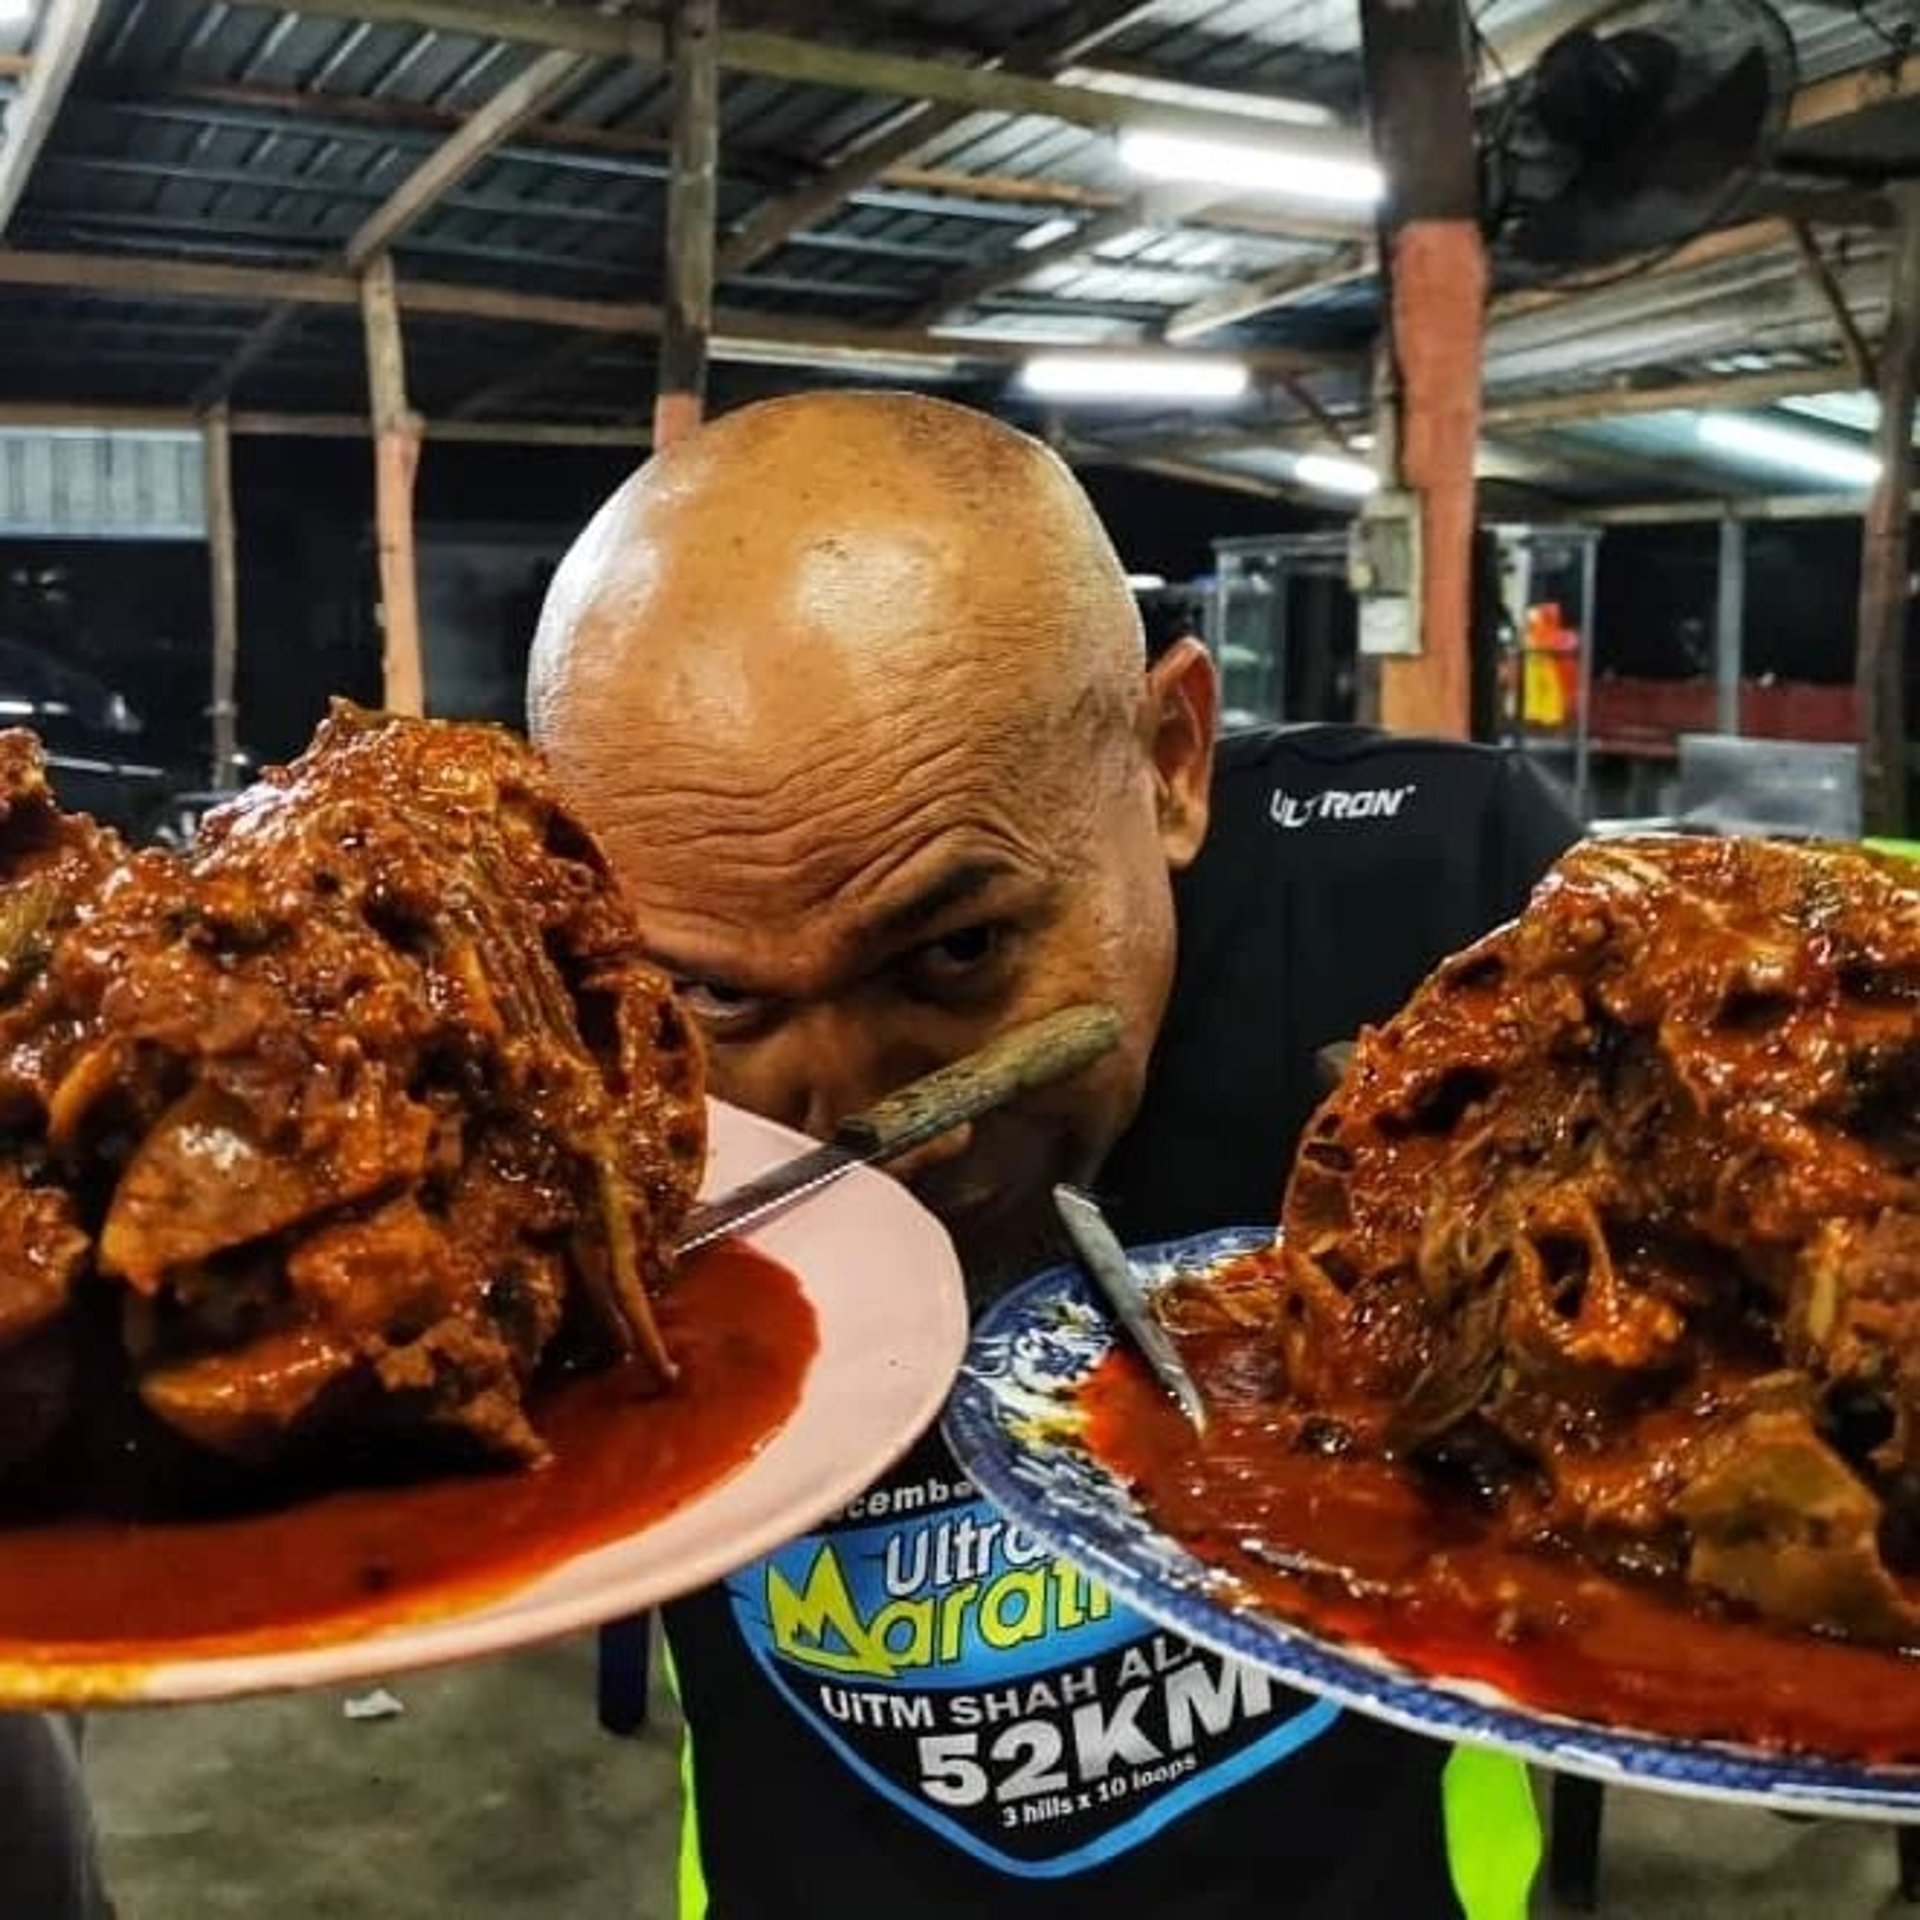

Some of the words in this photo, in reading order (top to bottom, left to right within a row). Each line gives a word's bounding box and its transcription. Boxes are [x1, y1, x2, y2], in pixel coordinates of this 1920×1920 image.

[949, 1665, 1097, 1725] SHAH
[1116, 1634, 1194, 1688] AL
[917, 1655, 1272, 1807] 52KM
[1001, 1806, 1018, 1828] 3
[1022, 1795, 1074, 1823] hills
[1077, 1793, 1092, 1811] x
[1097, 1776, 1127, 1802] 10
[1131, 1753, 1197, 1790] loops
